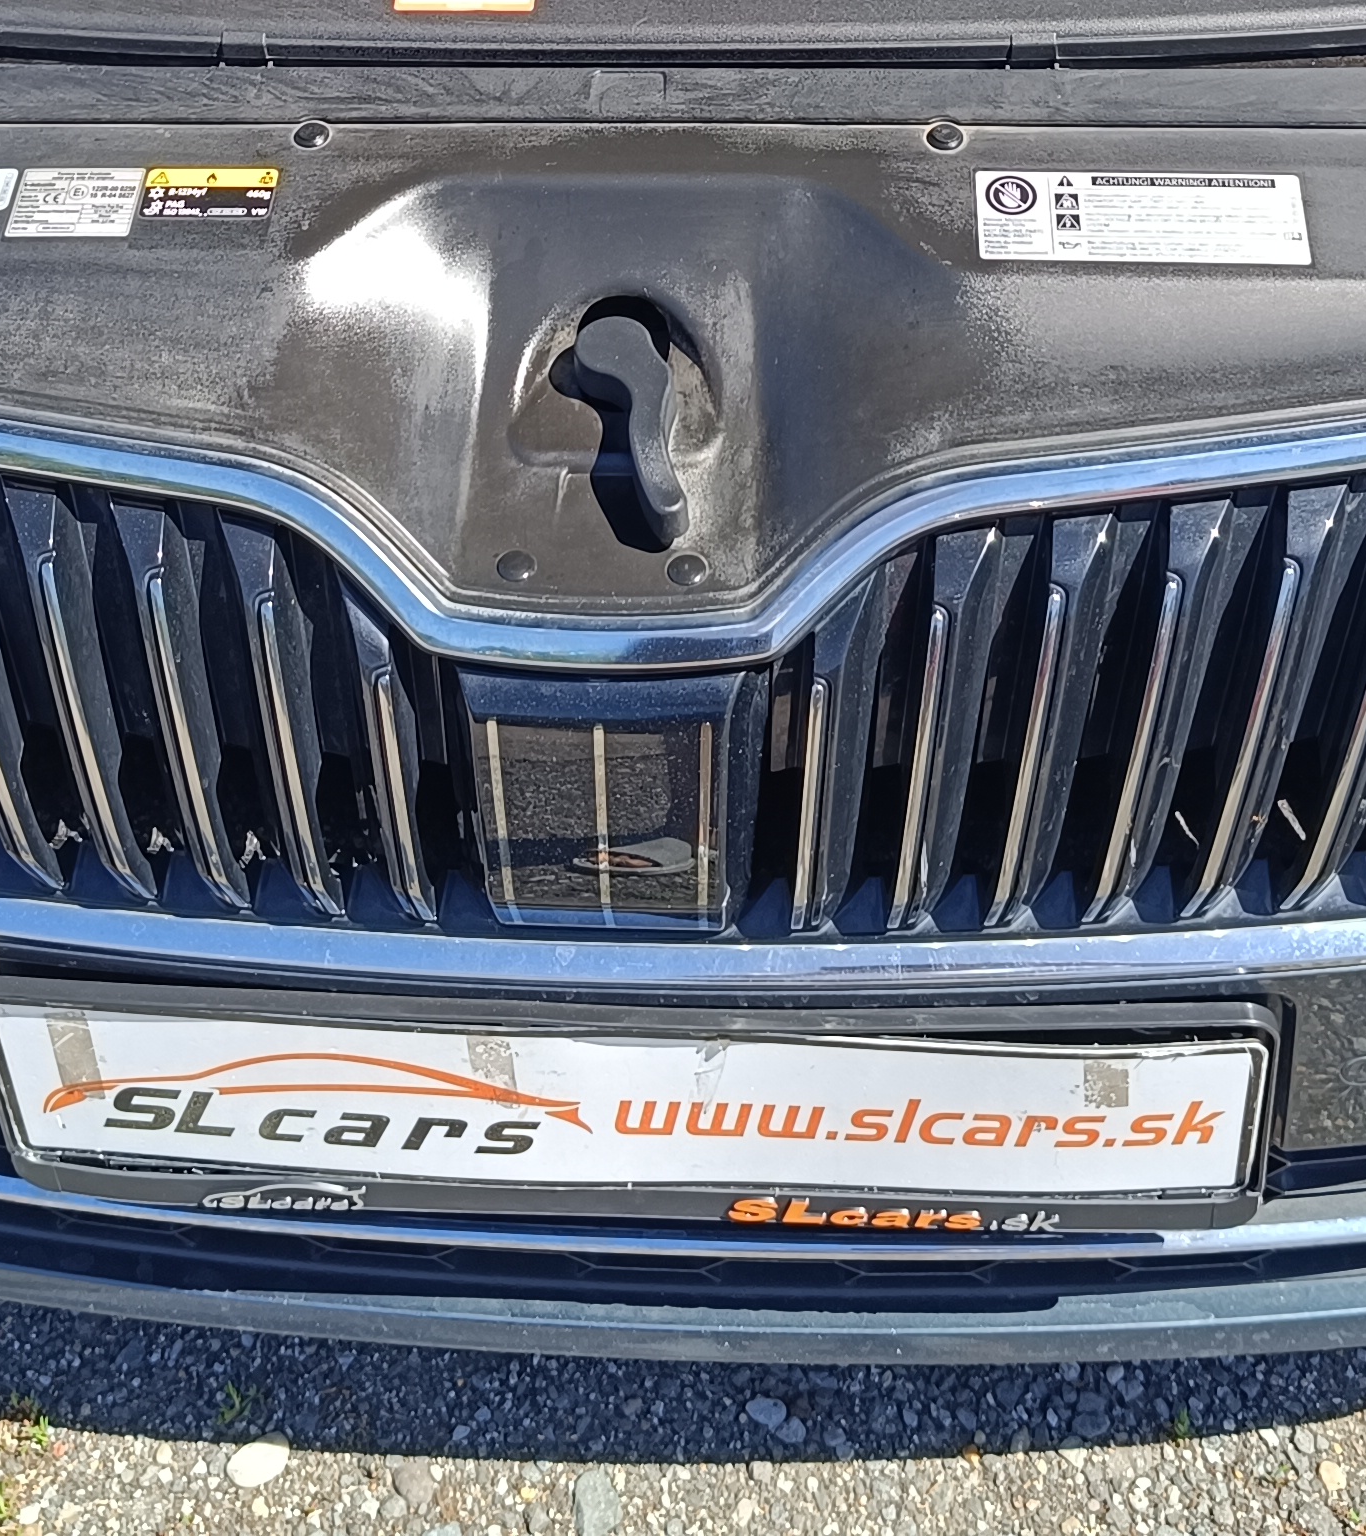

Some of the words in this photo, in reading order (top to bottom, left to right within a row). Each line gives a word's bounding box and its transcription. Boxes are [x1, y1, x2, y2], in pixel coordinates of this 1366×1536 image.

[1095, 177, 1152, 186] ACHTUNG!
[1153, 178, 1209, 187] WARNING!
[1210, 178, 1272, 188] ATTENTION!
[613, 1098, 1226, 1148] www.slcars.sk
